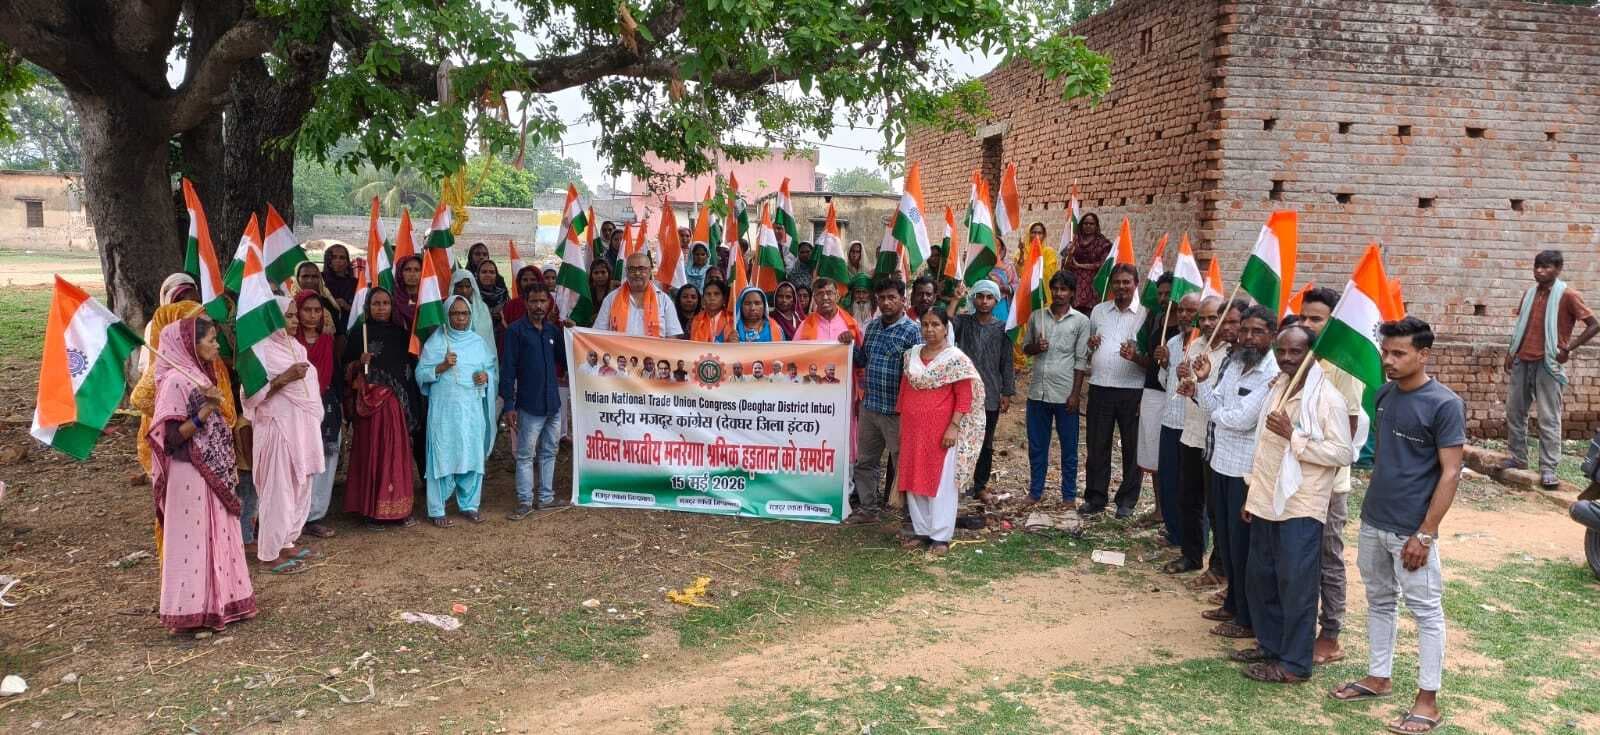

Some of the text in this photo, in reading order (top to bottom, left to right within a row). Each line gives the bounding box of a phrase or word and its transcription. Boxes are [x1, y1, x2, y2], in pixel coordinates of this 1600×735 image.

[585, 390, 835, 416] Indian National Trade Union Congress (Deoghar District Intuc)
[600, 409, 820, 435] राष्ट्रीय मजदूर कांग्रेस (देवघर जिला इंटक)
[586, 430, 620, 462] अखिल
[623, 432, 662, 465] भारतीय
[707, 436, 740, 468] श्रमिक
[742, 444, 781, 479] हड़ताल
[782, 440, 797, 471] को
[799, 440, 835, 472] समर्थन
[671, 473, 745, 491] 15 मई 2026
